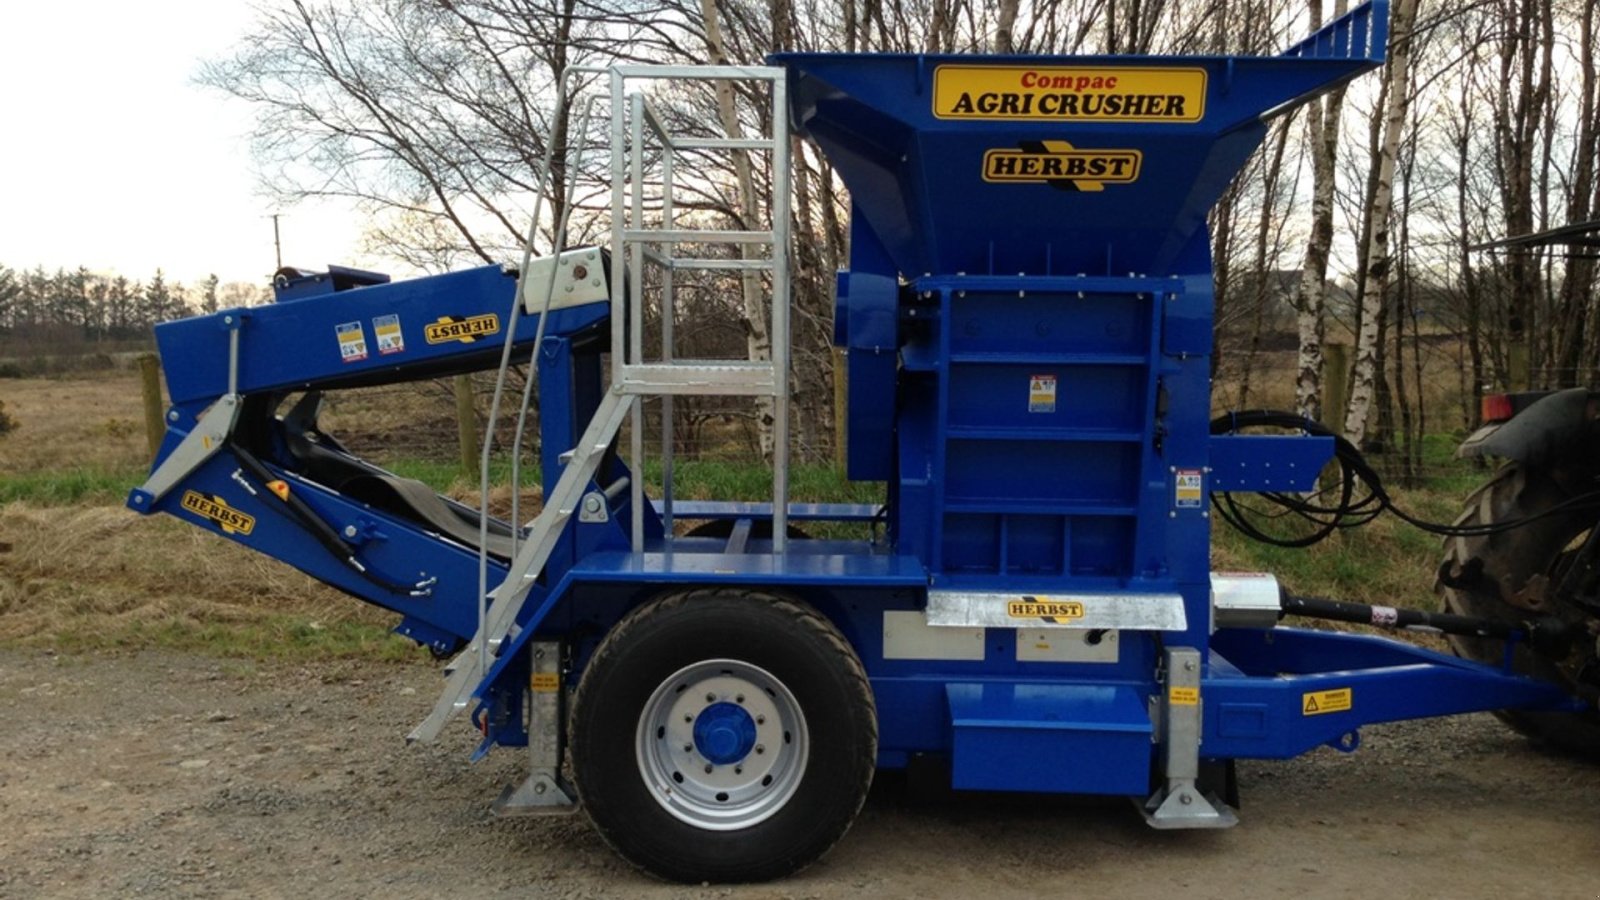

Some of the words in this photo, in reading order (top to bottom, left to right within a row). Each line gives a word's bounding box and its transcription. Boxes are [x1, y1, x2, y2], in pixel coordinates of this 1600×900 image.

[1021, 71, 1118, 92] Compac
[951, 92, 1034, 115] AGRI
[1037, 94, 1186, 117] CRUSHER
[993, 156, 1130, 176] HERBST
[431, 318, 495, 339] HERBST
[186, 495, 250, 529] HERBST
[1012, 604, 1079, 616] HERBST
